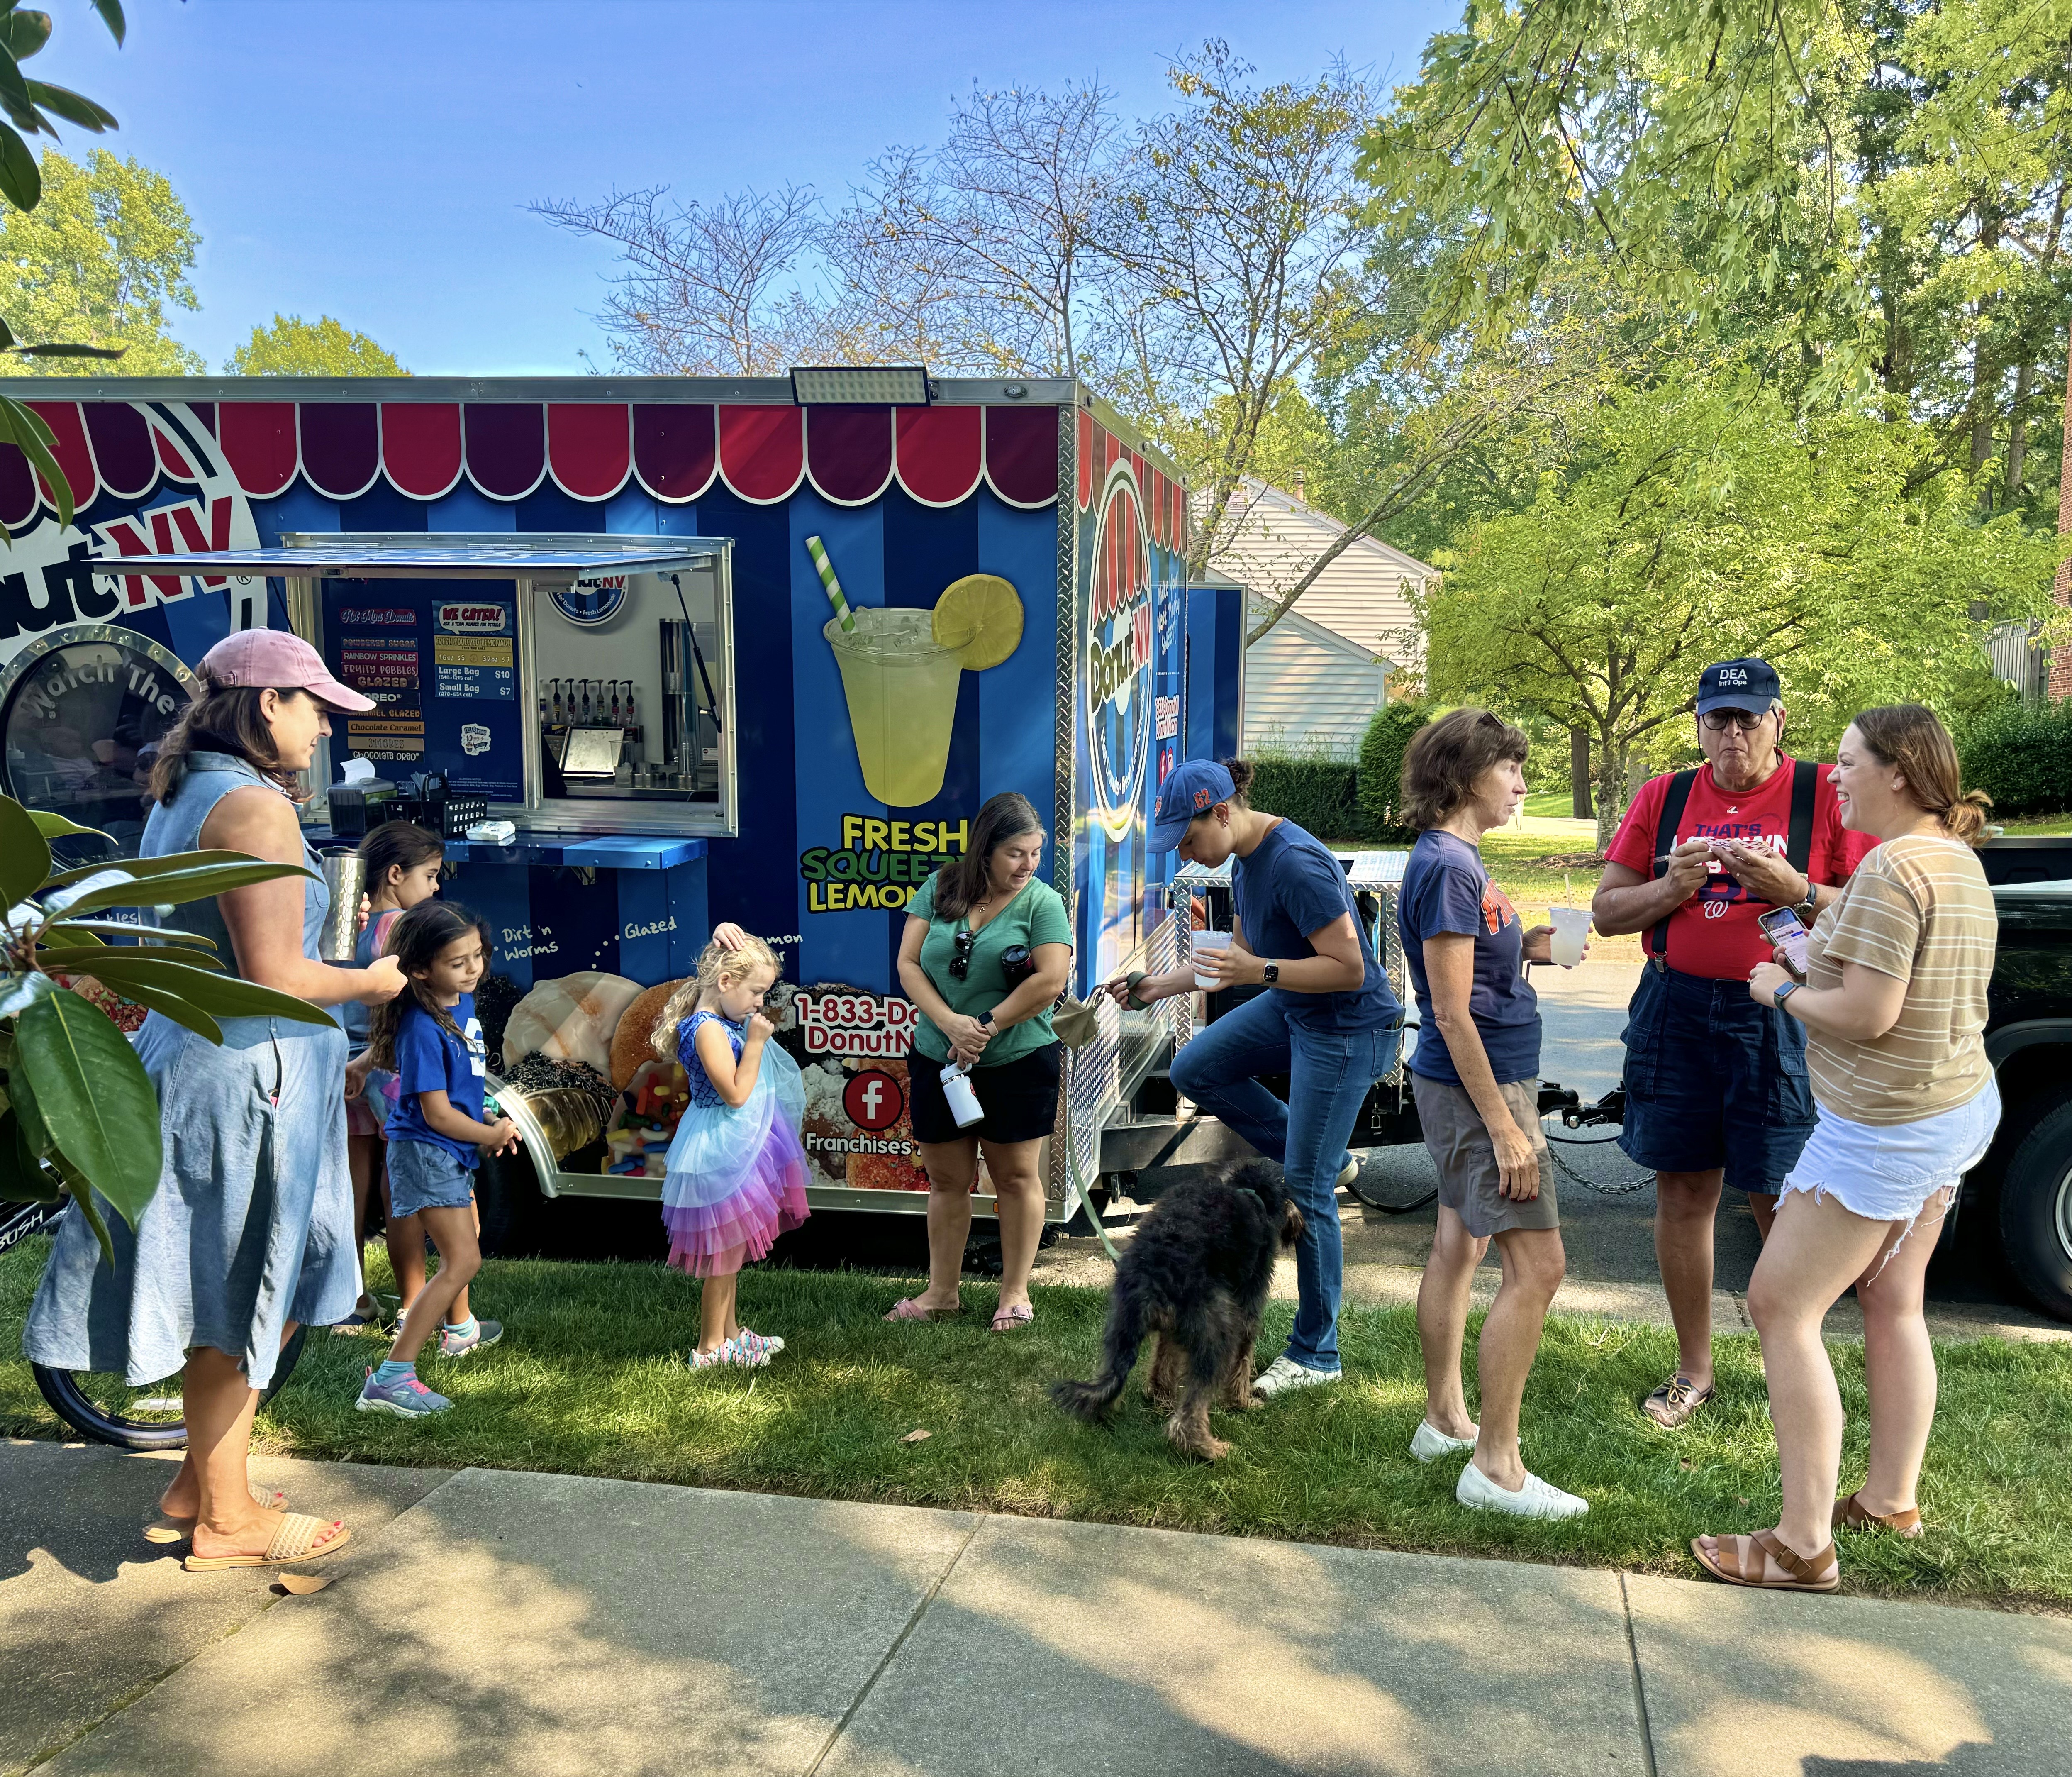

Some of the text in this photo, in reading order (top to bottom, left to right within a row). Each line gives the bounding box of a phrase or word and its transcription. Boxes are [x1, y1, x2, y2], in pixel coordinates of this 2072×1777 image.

[563, 600, 578, 613] Donuts
[597, 593, 616, 613] Lemonade
[341, 609, 360, 623] Hot
[385, 609, 414, 623] Donuts
[443, 608, 502, 621] WE CATER!
[343, 639, 416, 648] POWDERED SUGAR
[436, 637, 511, 647] FRESH SQUEEZED LEMONADE
[1091, 603, 1151, 713] DonutNV
[357, 676, 407, 687] GLAZED
[439, 666, 510, 679] Large Bag $10
[1719, 669, 1748, 679] DEA
[129, 663, 175, 715] The
[439, 683, 511, 696] Small Bag $7
[369, 738, 404, 749] S'MORES
[1099, 727, 1107, 765] Hot
[1106, 756, 1119, 796] Donuts
[1131, 684, 1145, 771] Lemonade
[1193, 788, 1212, 808] 62
[844, 815, 968, 853] FRESH
[1695, 824, 1762, 838] THAT'S
[803, 849, 965, 882] SQUEE
[502, 925, 532, 943] Dirt
[624, 916, 677, 939] Glazed
[504, 941, 558, 961] Worms
[807, 1133, 912, 1155] Franchises
